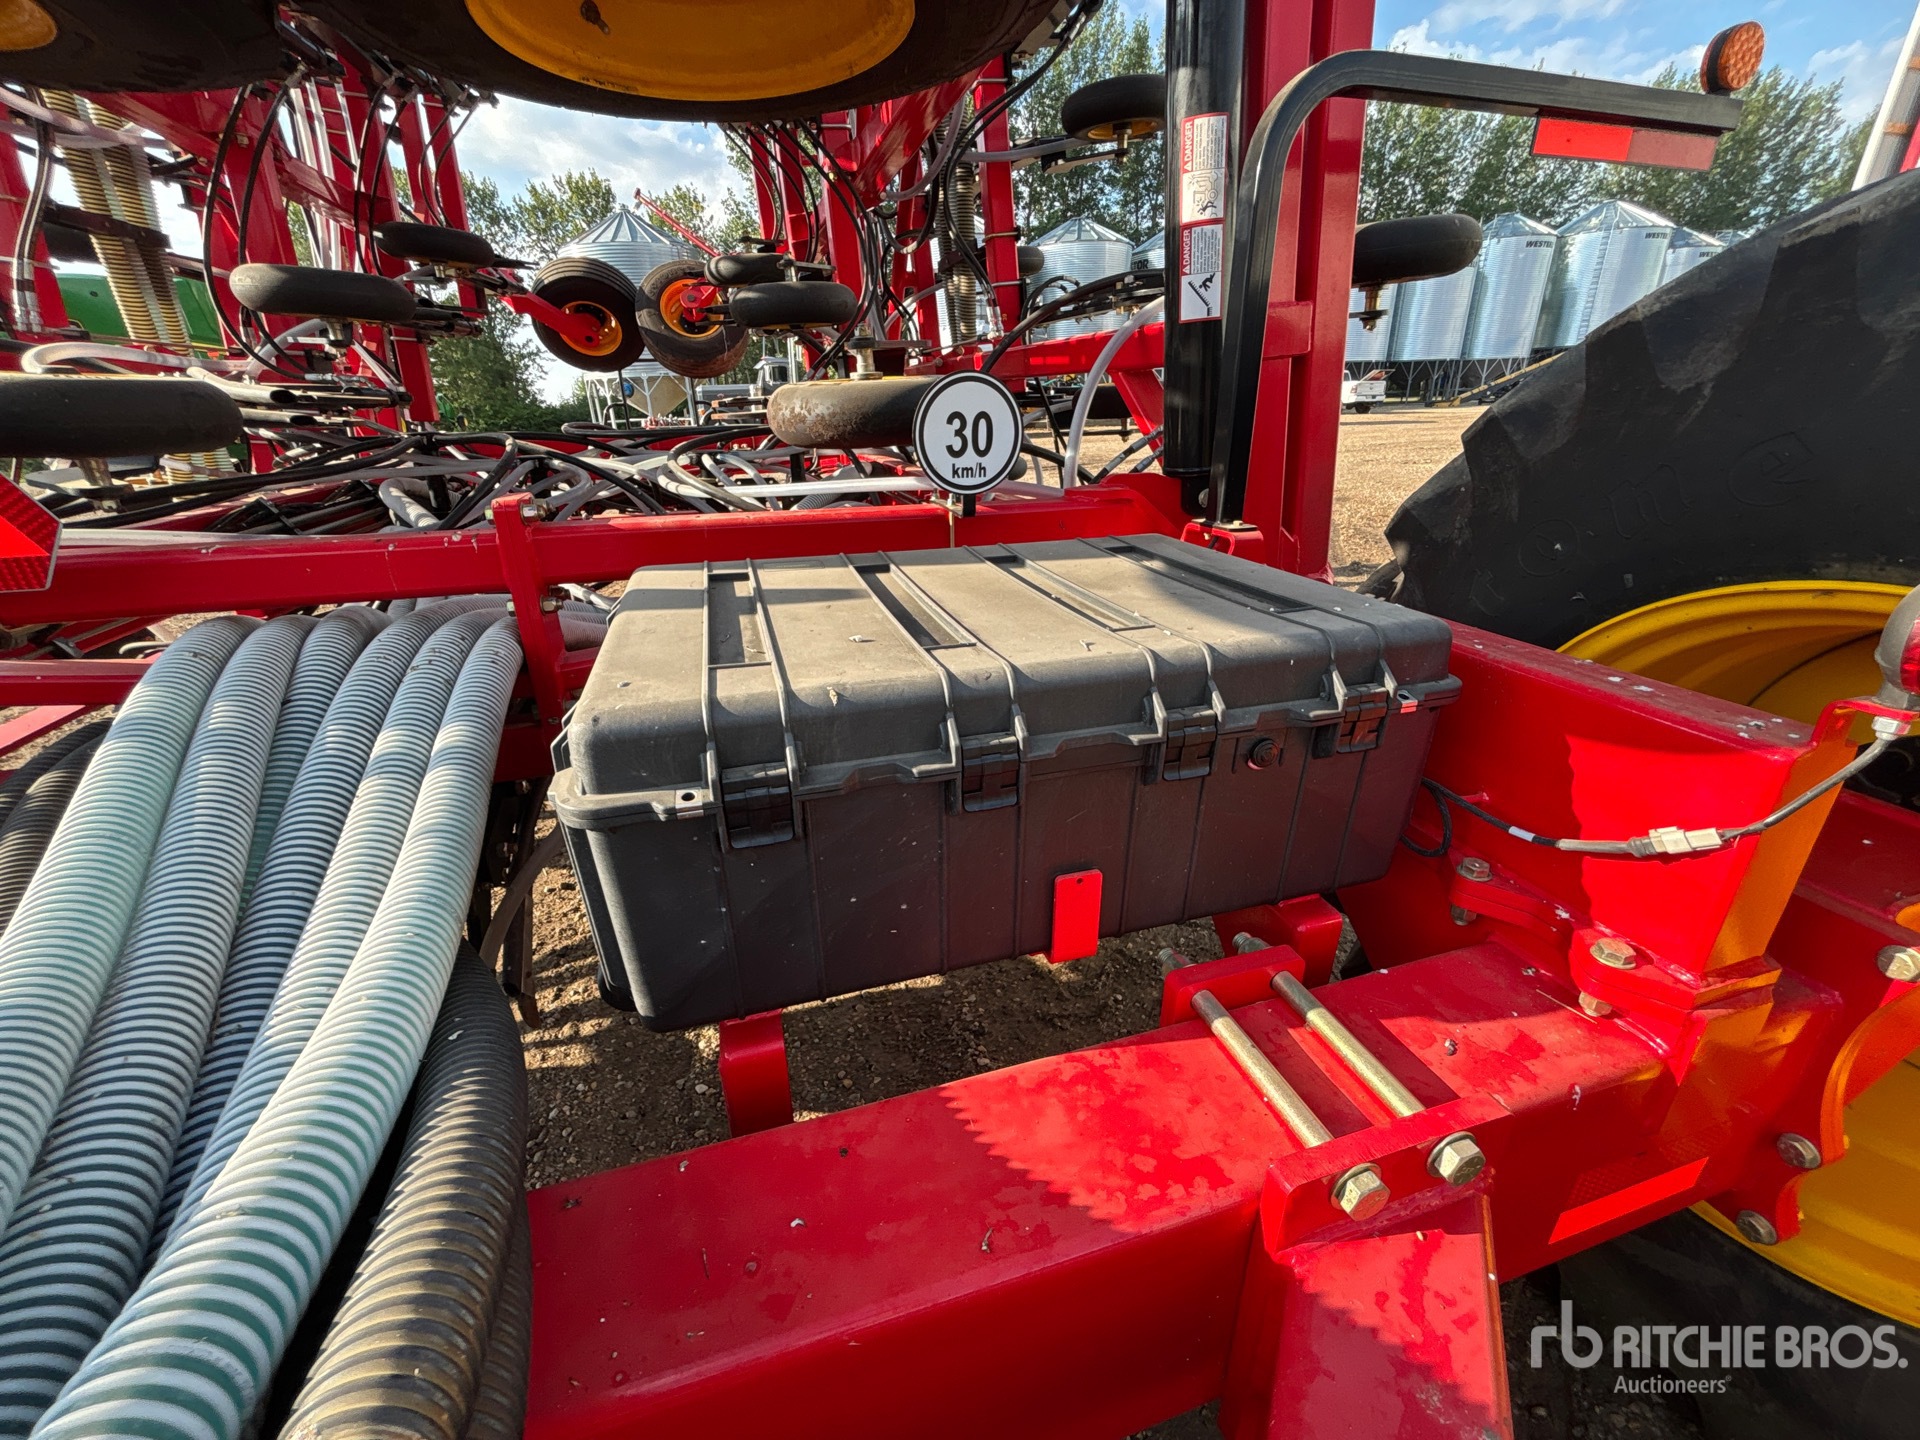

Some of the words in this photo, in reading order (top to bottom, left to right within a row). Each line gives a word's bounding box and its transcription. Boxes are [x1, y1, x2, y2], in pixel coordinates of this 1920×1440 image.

[1184, 121, 1193, 162] DANGER
[1183, 229, 1191, 265] DANGER
[945, 410, 994, 459] 30
[951, 462, 987, 479] km/h
